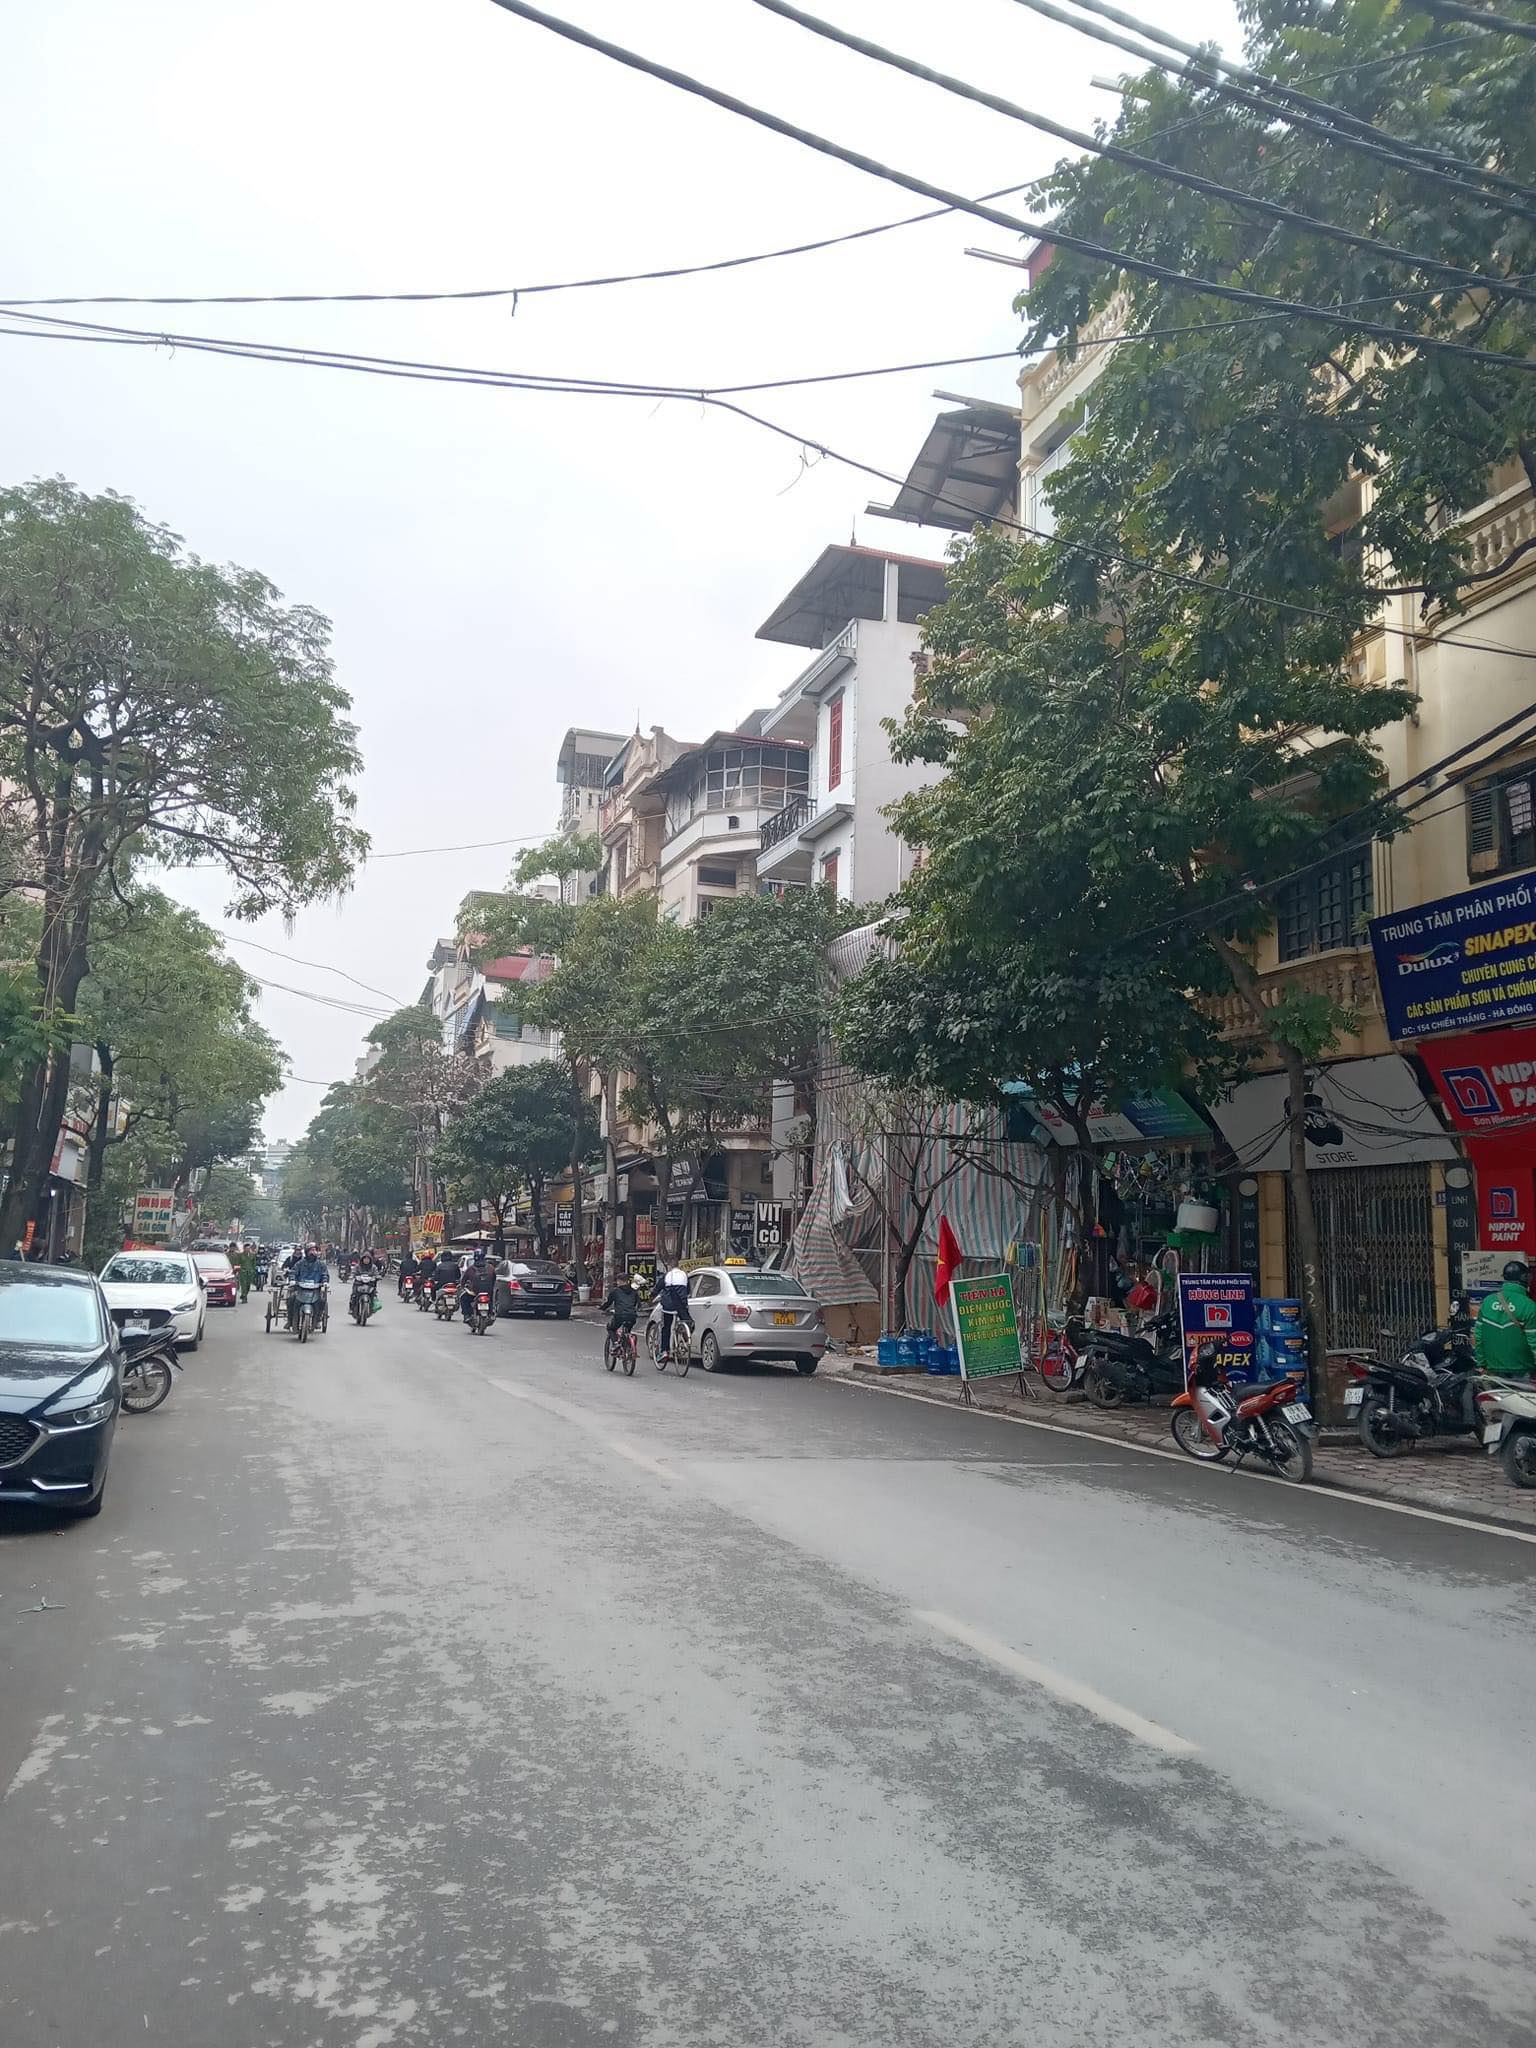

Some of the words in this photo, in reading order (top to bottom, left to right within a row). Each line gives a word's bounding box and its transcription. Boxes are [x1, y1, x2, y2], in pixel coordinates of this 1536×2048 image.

[1381, 920, 1424, 942] TRUNG
[1425, 910, 1454, 931] TÂM
[1456, 899, 1494, 923] PHÂN
[1497, 883, 1532, 912] PHỐI
[1464, 922, 1536, 956] SINAPEX
[1398, 953, 1456, 976] Dulux
[1461, 960, 1498, 985] CHUYÊN
[1500, 957, 1527, 976] CUNG
[1406, 1001, 1424, 1019] CÁC
[1425, 996, 1444, 1017] SẢN
[1444, 989, 1471, 1013] PHẨM
[1472, 988, 1493, 1004] SƠN
[1494, 984, 1507, 1001] VÀ
[1417, 1023, 1431, 1034] 154
[1431, 1016, 1457, 1031] CHIẾN
[1493, 1007, 1506, 1018] HÀ
[1507, 1002, 1535, 1017] ĐÔNG
[1315, 1151, 1358, 1164] STORE
[1451, 1195, 1468, 1206] LINH
[758, 1202, 782, 1226] VỊT
[759, 1225, 780, 1244] CỎ
[1488, 1221, 1526, 1233] NIPPON
[1491, 1231, 1521, 1242] PAINT
[1220, 1289, 1246, 1301] LINH
